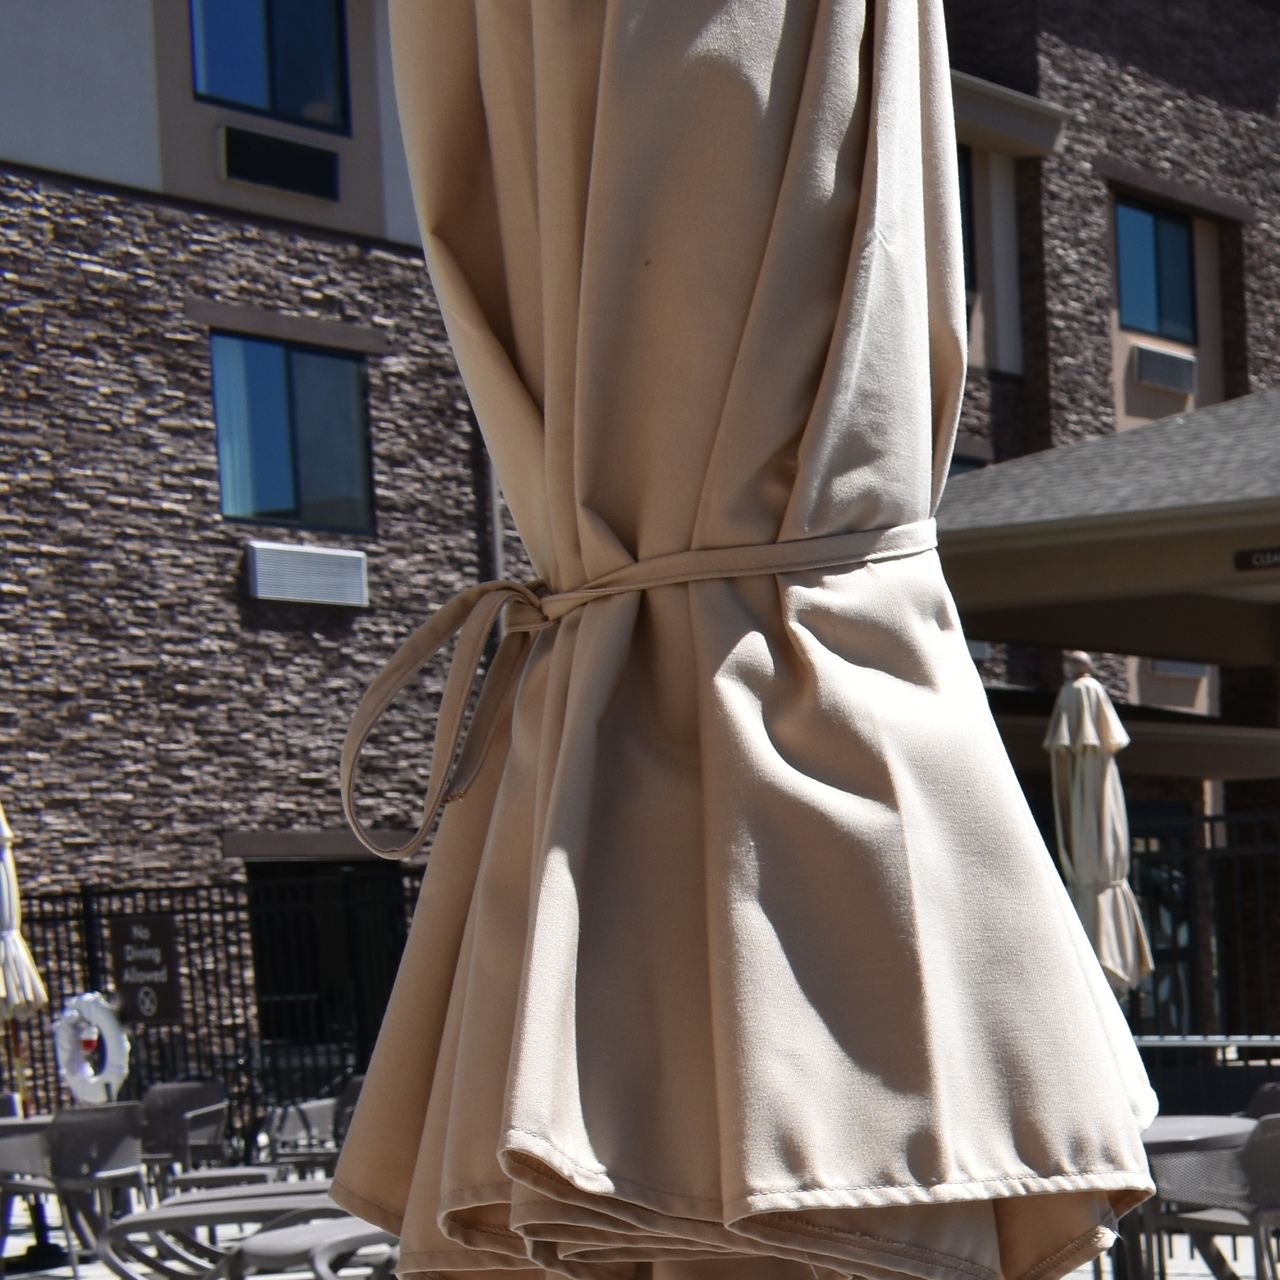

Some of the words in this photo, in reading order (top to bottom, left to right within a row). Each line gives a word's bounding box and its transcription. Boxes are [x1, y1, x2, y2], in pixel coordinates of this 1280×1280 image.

[131, 924, 151, 941] No
[123, 943, 162, 965] Diving
[123, 964, 168, 984] Allowed
